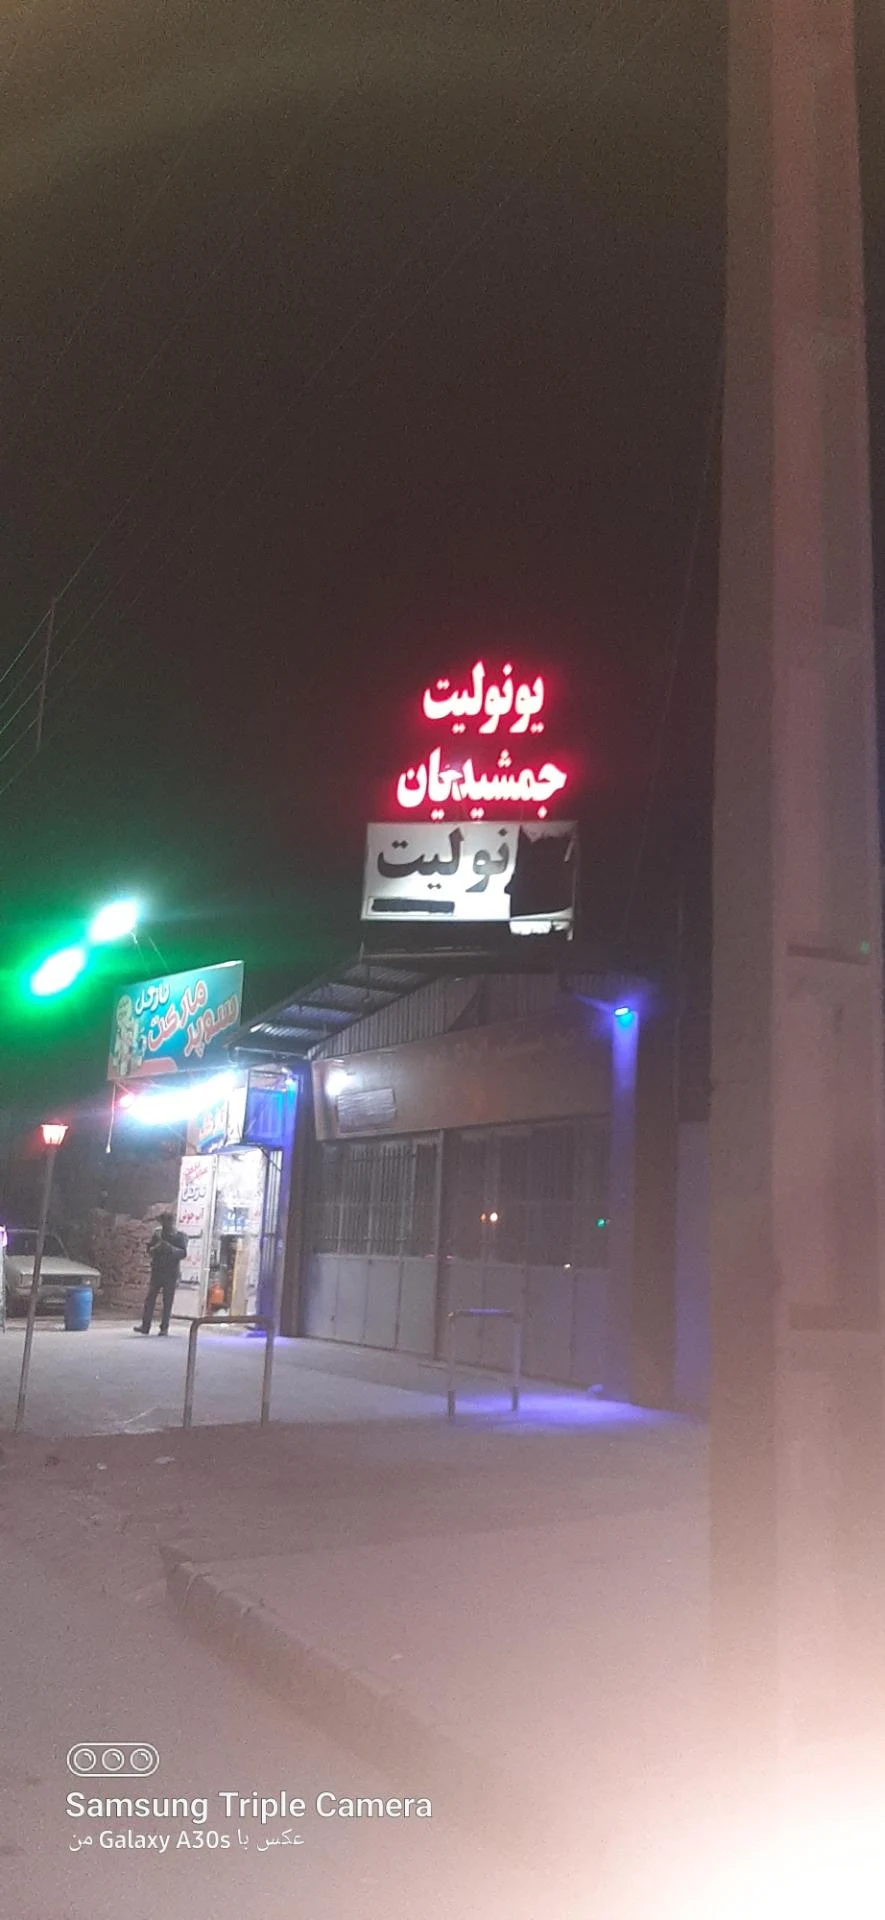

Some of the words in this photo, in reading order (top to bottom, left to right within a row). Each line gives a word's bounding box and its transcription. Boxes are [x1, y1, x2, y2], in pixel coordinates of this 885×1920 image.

[422, 660, 545, 734] یونولیت
[376, 826, 512, 893] نولیت
[147, 979, 209, 1051] مارکت
